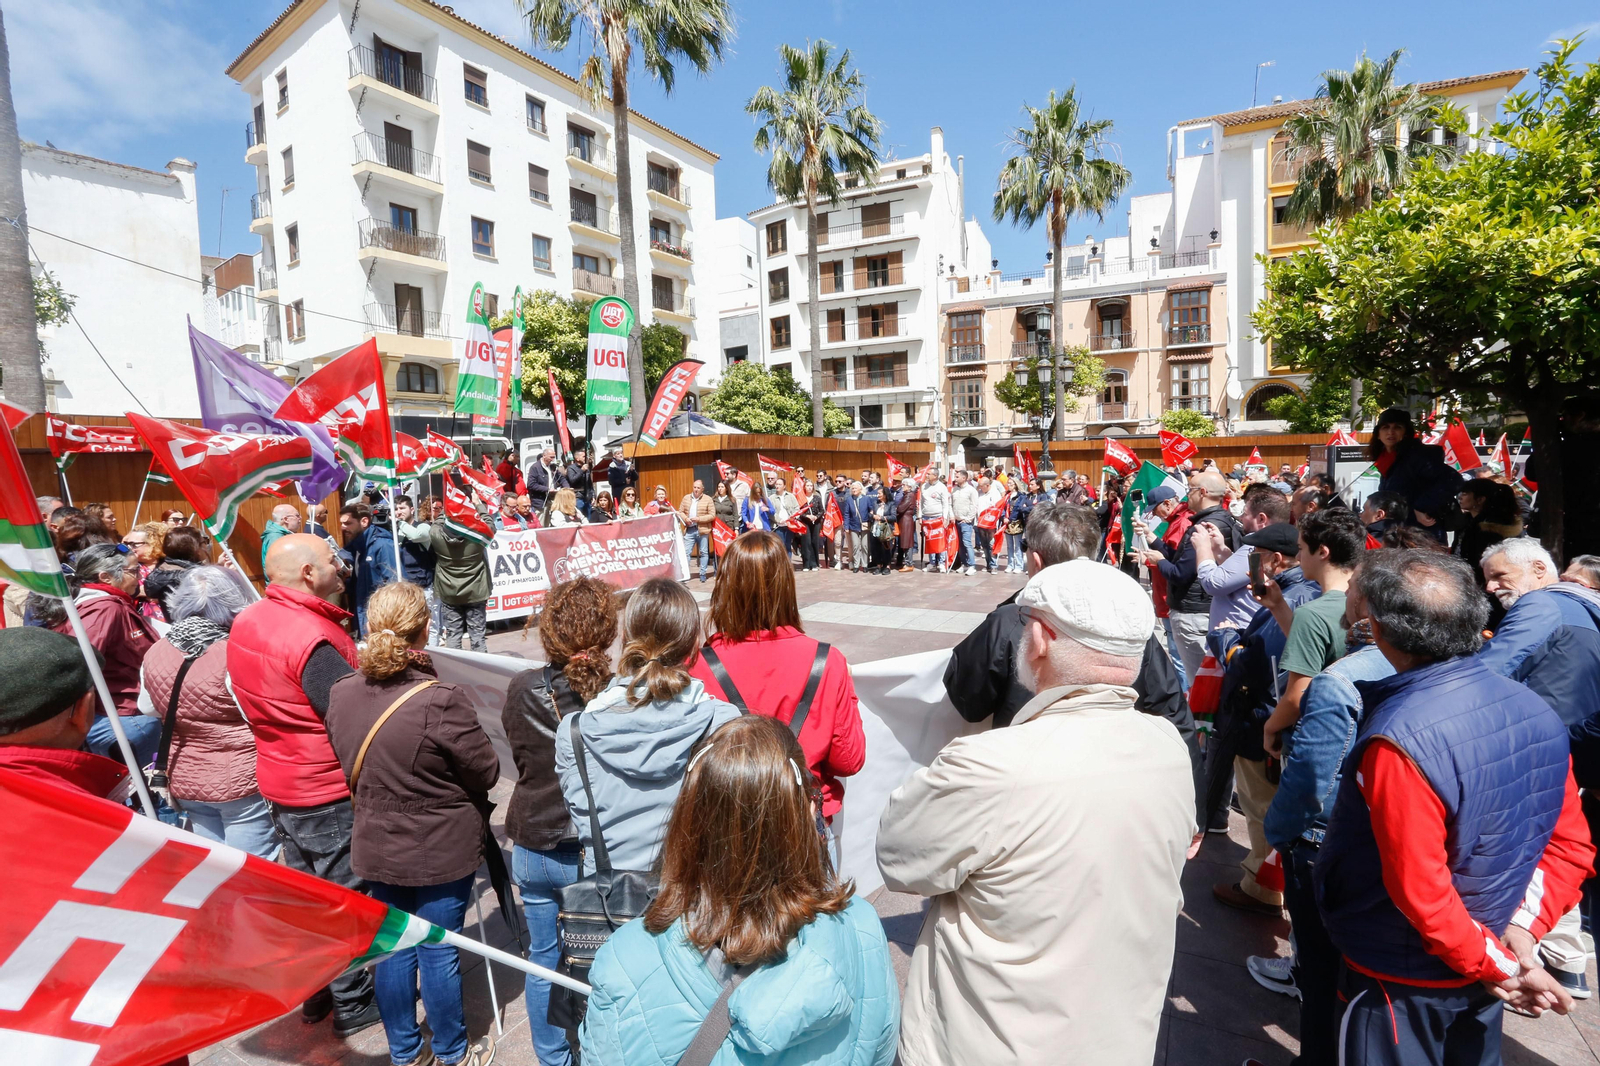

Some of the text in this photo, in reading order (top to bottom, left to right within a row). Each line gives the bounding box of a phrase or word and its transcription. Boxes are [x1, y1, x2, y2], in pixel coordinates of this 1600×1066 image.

[604, 305, 622, 317] UGT
[593, 349, 626, 368] UGT
[592, 393, 628, 403] Andalucía
[508, 540, 536, 552] 2024
[607, 538, 638, 551] PLENO
[638, 531, 676, 547] EMPLEO
[493, 552, 541, 578] AYO
[566, 551, 612, 571] MENOS
[626, 554, 672, 570] SALARIOS
[504, 597, 522, 607] UGT
